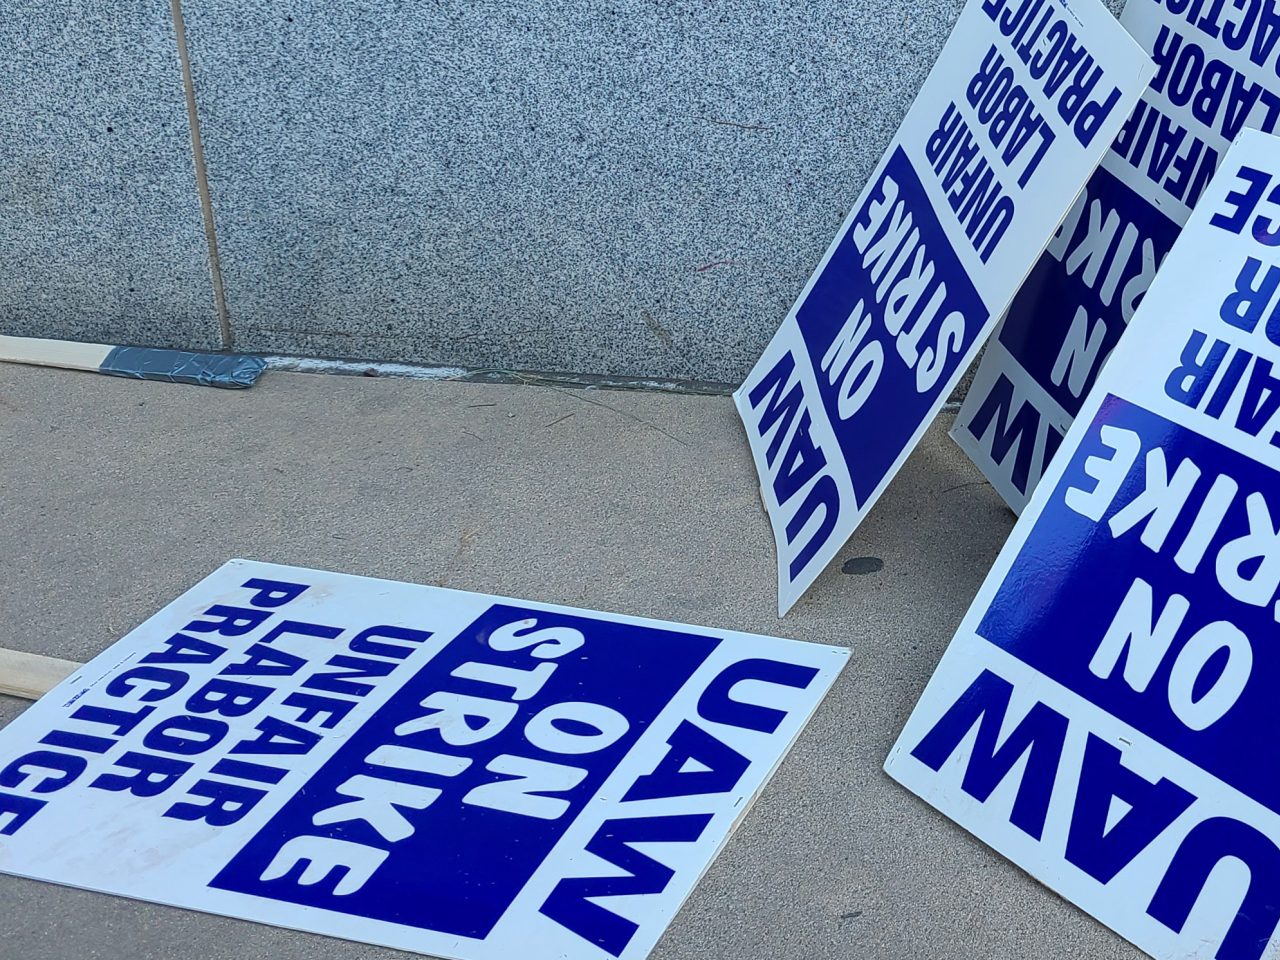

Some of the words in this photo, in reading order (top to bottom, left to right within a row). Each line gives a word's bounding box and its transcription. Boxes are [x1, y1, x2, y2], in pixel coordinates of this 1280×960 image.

[925, 100, 1015, 265] UNFAIR
[966, 43, 1056, 188] LABOR
[1110, 98, 1219, 210] NFAIR
[821, 298, 884, 421] ON
[853, 174, 965, 393] STRIKE
[1051, 305, 1114, 398] N
[748, 350, 840, 583] UAW
[88, 619, 347, 797] LABOR
[161, 624, 435, 827] UNFAIR
[1089, 577, 1253, 731] ON
[259, 617, 585, 897] STRIKE
[462, 701, 630, 821] ON
[538, 657, 820, 958] UAW
